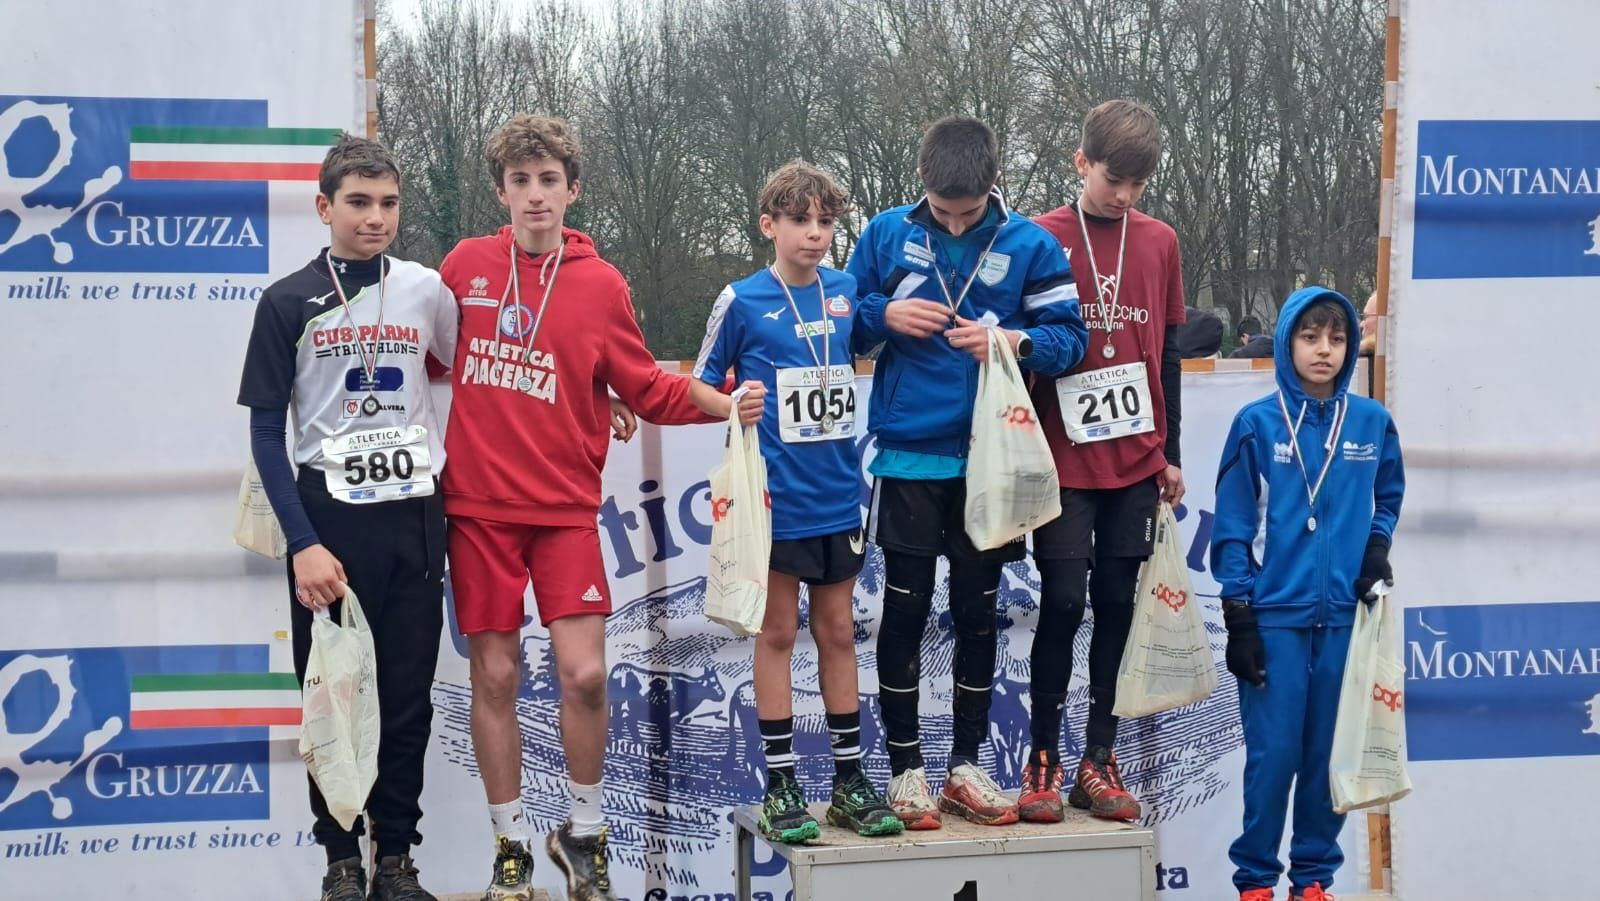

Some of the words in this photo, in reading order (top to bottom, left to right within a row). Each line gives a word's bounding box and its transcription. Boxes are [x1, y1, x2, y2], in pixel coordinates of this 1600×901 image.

[1419, 154, 1600, 195] MONTANA
[85, 200, 264, 248] GRUZZA
[7, 276, 71, 300] milk
[81, 285, 119, 300] we
[131, 281, 198, 300] trust
[208, 279, 263, 300] sinc
[313, 327, 351, 347] CUS
[357, 324, 420, 345] PARMA
[1086, 320, 1124, 330] BOLONA
[332, 341, 409, 357] TRIATHLON
[469, 337, 555, 370] ATLETICA
[461, 354, 557, 405] PIACENZA
[1081, 368, 1128, 385] ATLETICA
[785, 386, 856, 423] 1054
[1078, 385, 1140, 425] 210
[348, 430, 401, 446] ATLETICA
[344, 449, 415, 486] 580
[85, 752, 264, 799] GRUZZA
[6, 832, 69, 857] milk
[80, 839, 119, 854] we
[131, 831, 196, 851] trust
[208, 826, 280, 848] since
